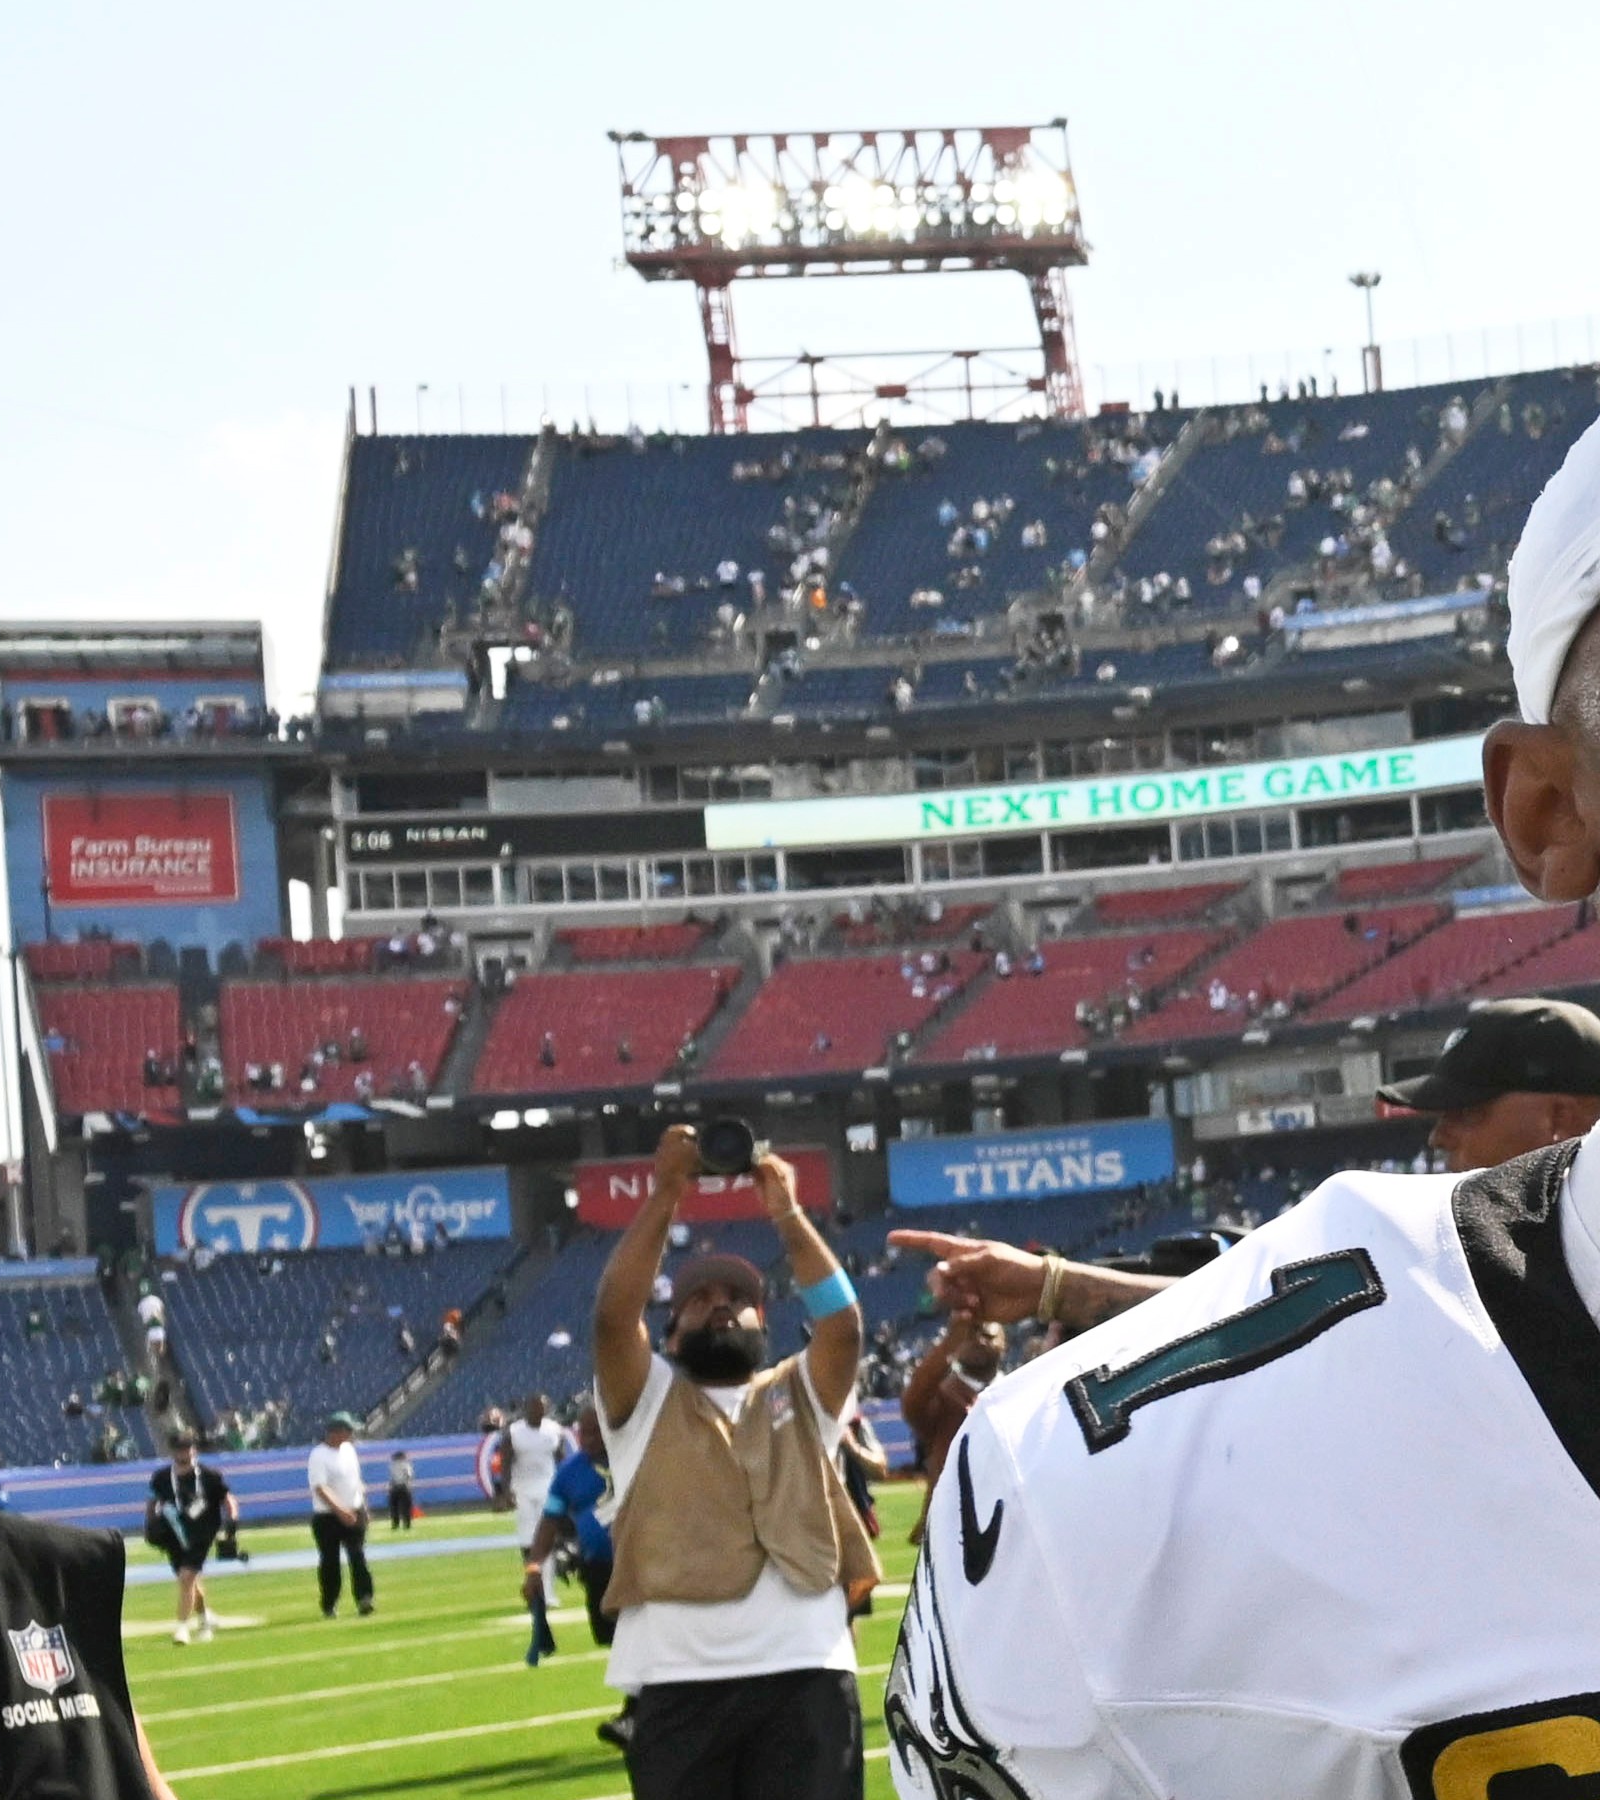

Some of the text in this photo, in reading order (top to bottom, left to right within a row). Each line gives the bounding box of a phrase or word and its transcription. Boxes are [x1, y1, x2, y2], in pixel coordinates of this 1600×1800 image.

[922, 753, 1418, 831] NEXT HOME GAME
[71, 834, 211, 857] Farm Bureau
[406, 825, 488, 843] NISSAN
[71, 856, 210, 879] INSURANCE
[943, 1149, 1124, 1198] TITANS
[394, 1184, 497, 1237] Kroger
[1064, 1247, 1386, 1454] 1
[25, 1651, 67, 1681] NFL
[2, 1699, 59, 1729] SOCIAL
